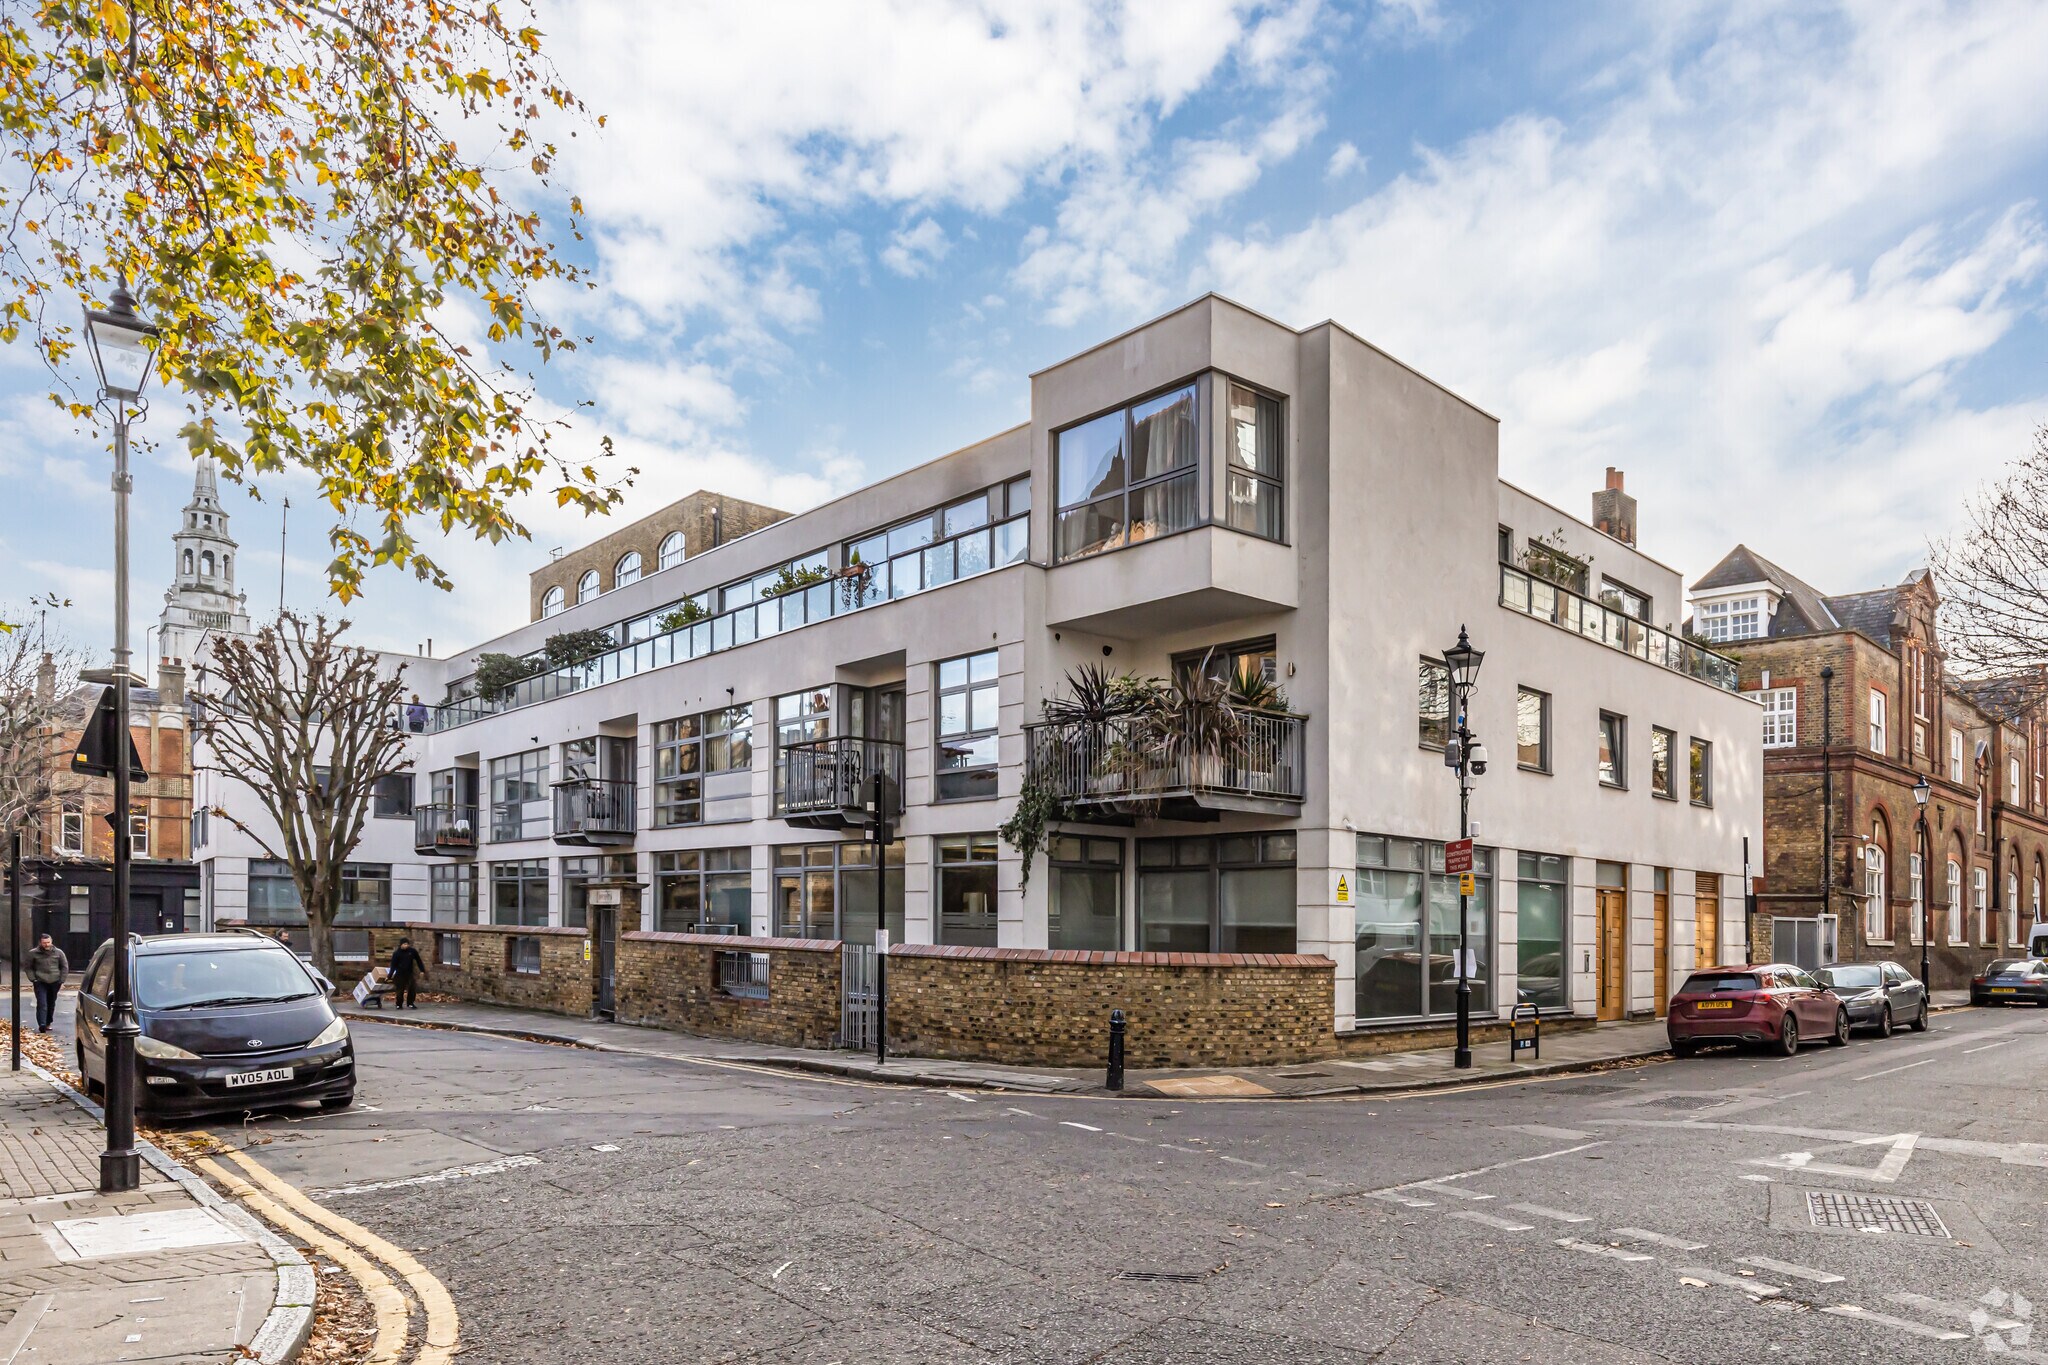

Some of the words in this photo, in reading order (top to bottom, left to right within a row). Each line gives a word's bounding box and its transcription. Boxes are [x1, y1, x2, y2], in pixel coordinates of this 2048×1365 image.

[1446, 849, 1472, 858] CONSTRUCTION
[231, 1072, 263, 1085] WV05
[266, 1069, 289, 1081] AOL
